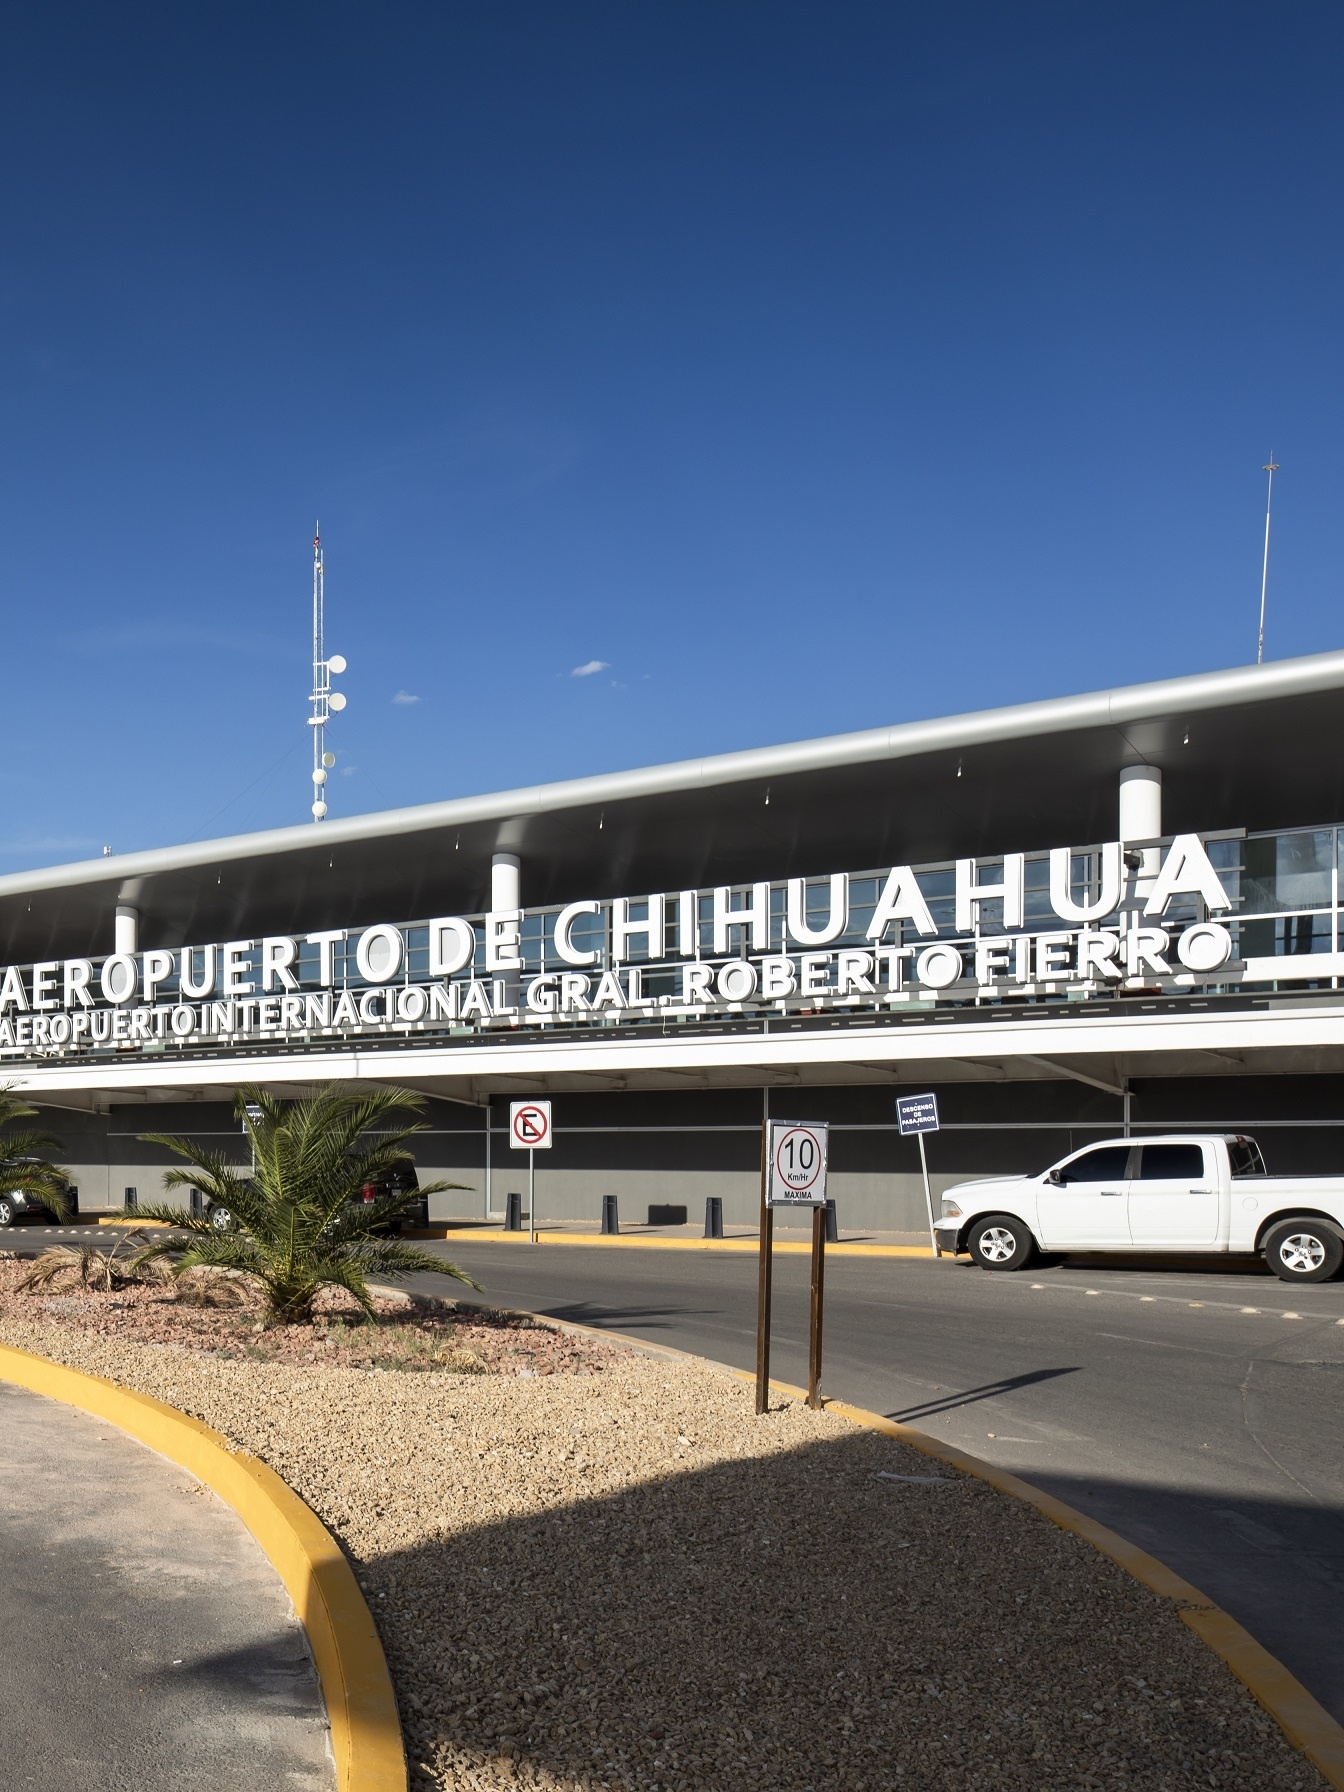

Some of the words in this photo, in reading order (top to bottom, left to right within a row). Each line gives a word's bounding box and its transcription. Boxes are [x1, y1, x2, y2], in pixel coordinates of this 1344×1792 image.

[428, 909, 526, 977] DE
[553, 833, 1233, 965] CHIHUAHUA
[202, 979, 519, 1036] INTERNACIONAL
[682, 945, 963, 1003] ROBERTO
[975, 922, 1233, 986] FIERRO
[902, 1103, 934, 1113] DESCENSO
[523, 1113, 538, 1136] E
[901, 1115, 936, 1126] PASAJEROS
[784, 1138, 814, 1169] 10
[787, 1173, 809, 1182] Km/Hr
[784, 1191, 812, 1199] MAXIMA
